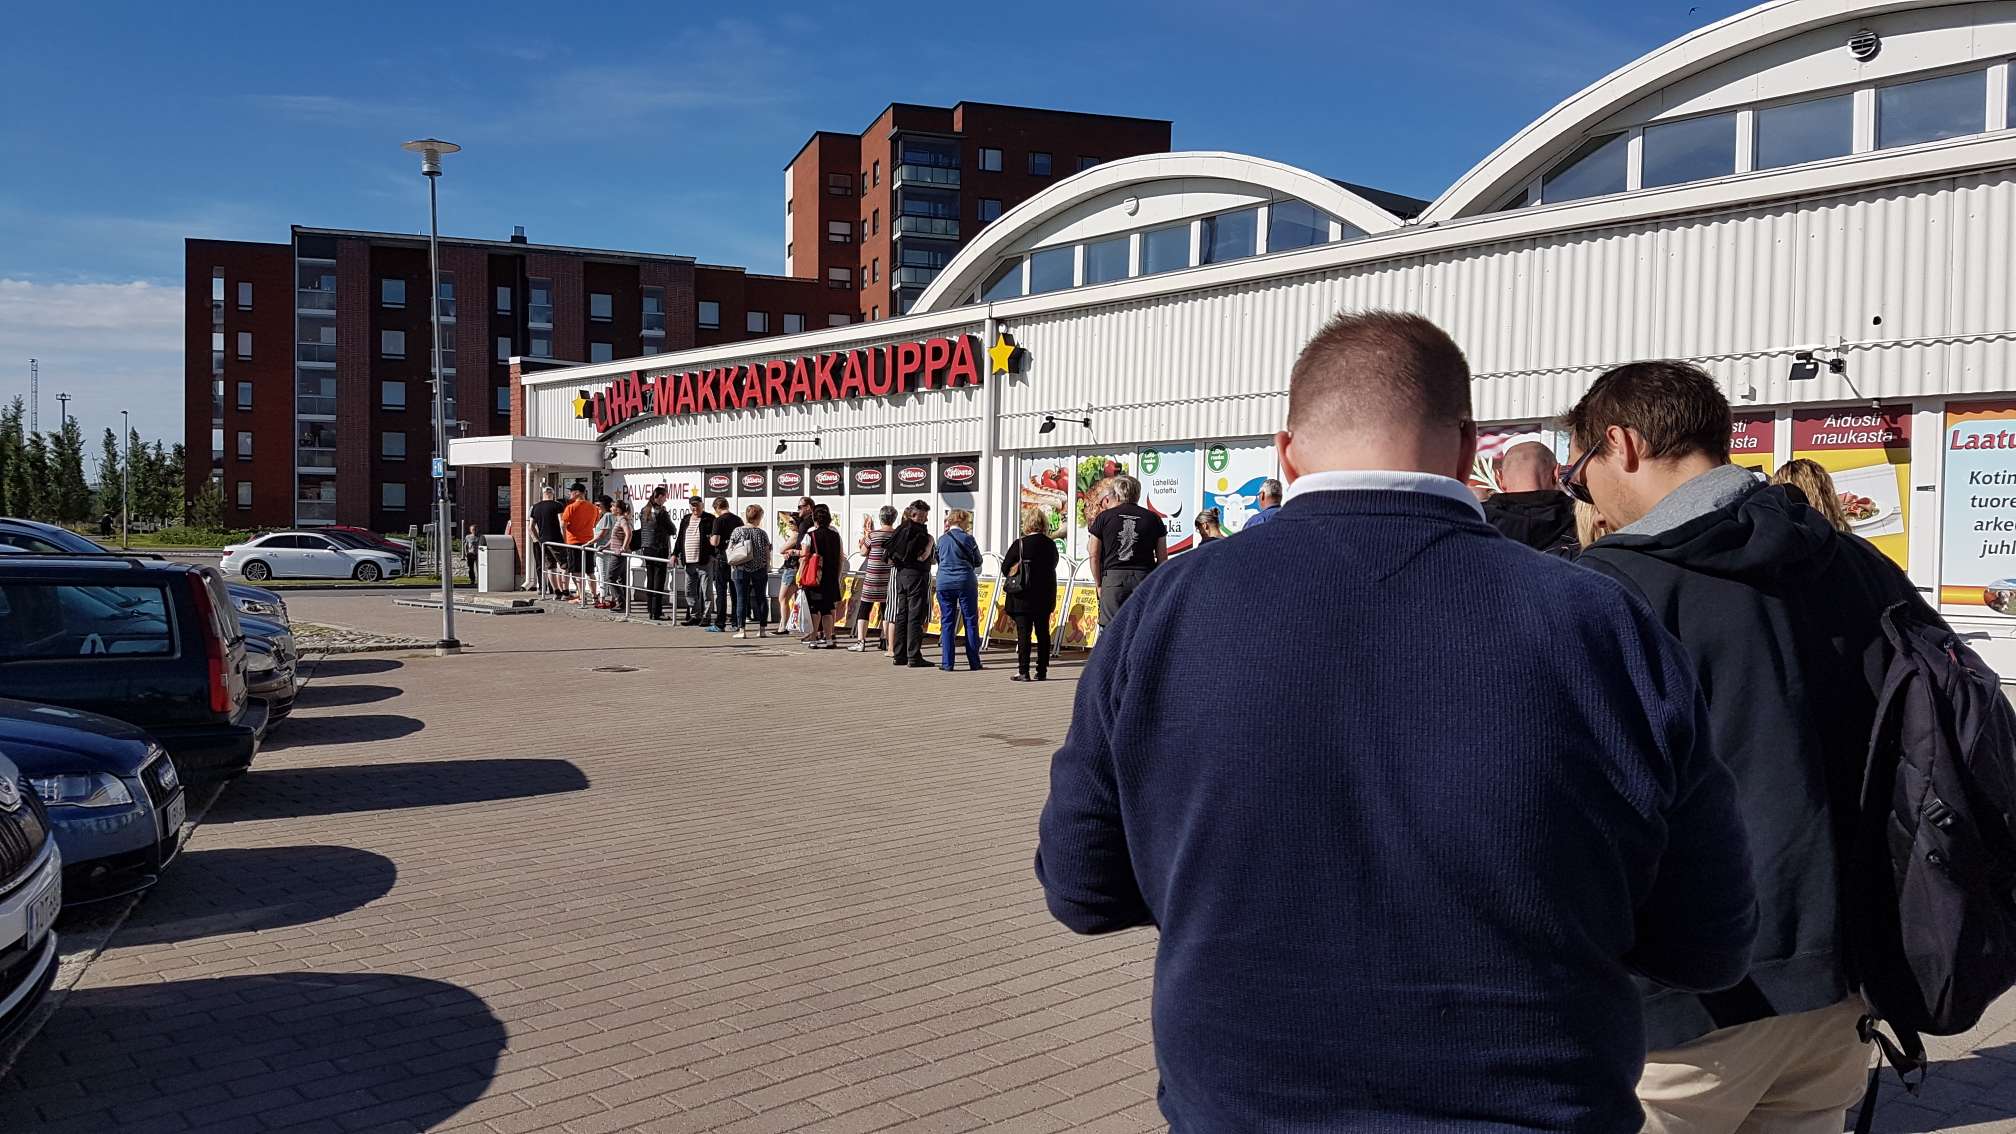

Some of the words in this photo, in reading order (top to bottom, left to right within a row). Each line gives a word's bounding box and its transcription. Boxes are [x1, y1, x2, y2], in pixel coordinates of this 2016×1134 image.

[653, 334, 977, 416] MAKKARAKAUPPA
[1823, 413, 1881, 428] Aidosti
[1811, 429, 1893, 444] maukasta
[622, 482, 690, 501] PALVEMME
[1974, 516, 2016, 531] arke
